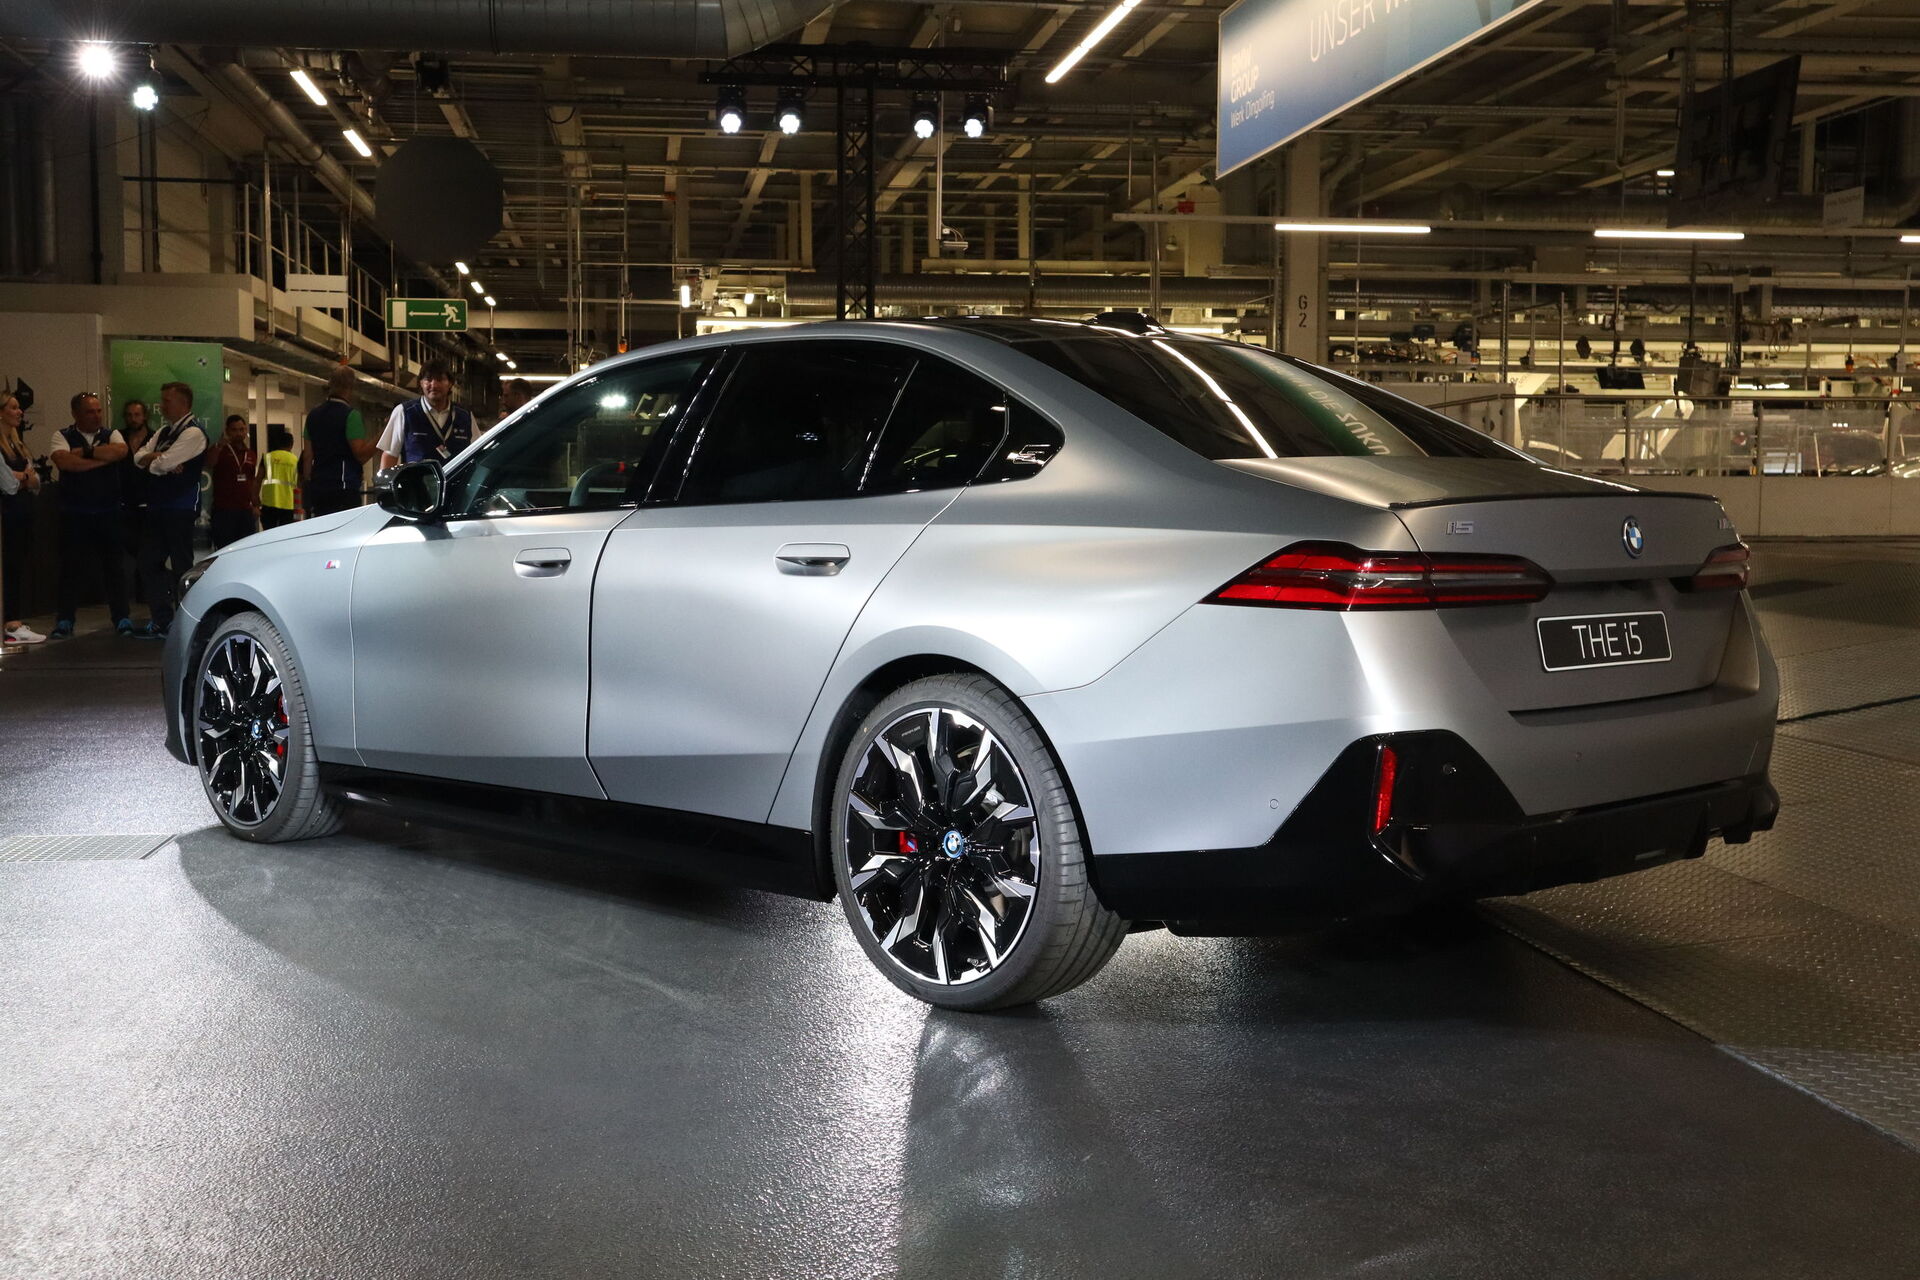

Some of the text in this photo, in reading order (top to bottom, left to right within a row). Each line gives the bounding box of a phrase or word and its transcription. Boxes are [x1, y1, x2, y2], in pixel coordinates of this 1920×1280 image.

[1310, 0, 1375, 62] UNSER
[1230, 65, 1259, 104] GROUP
[1571, 621, 1643, 659] THE i5
